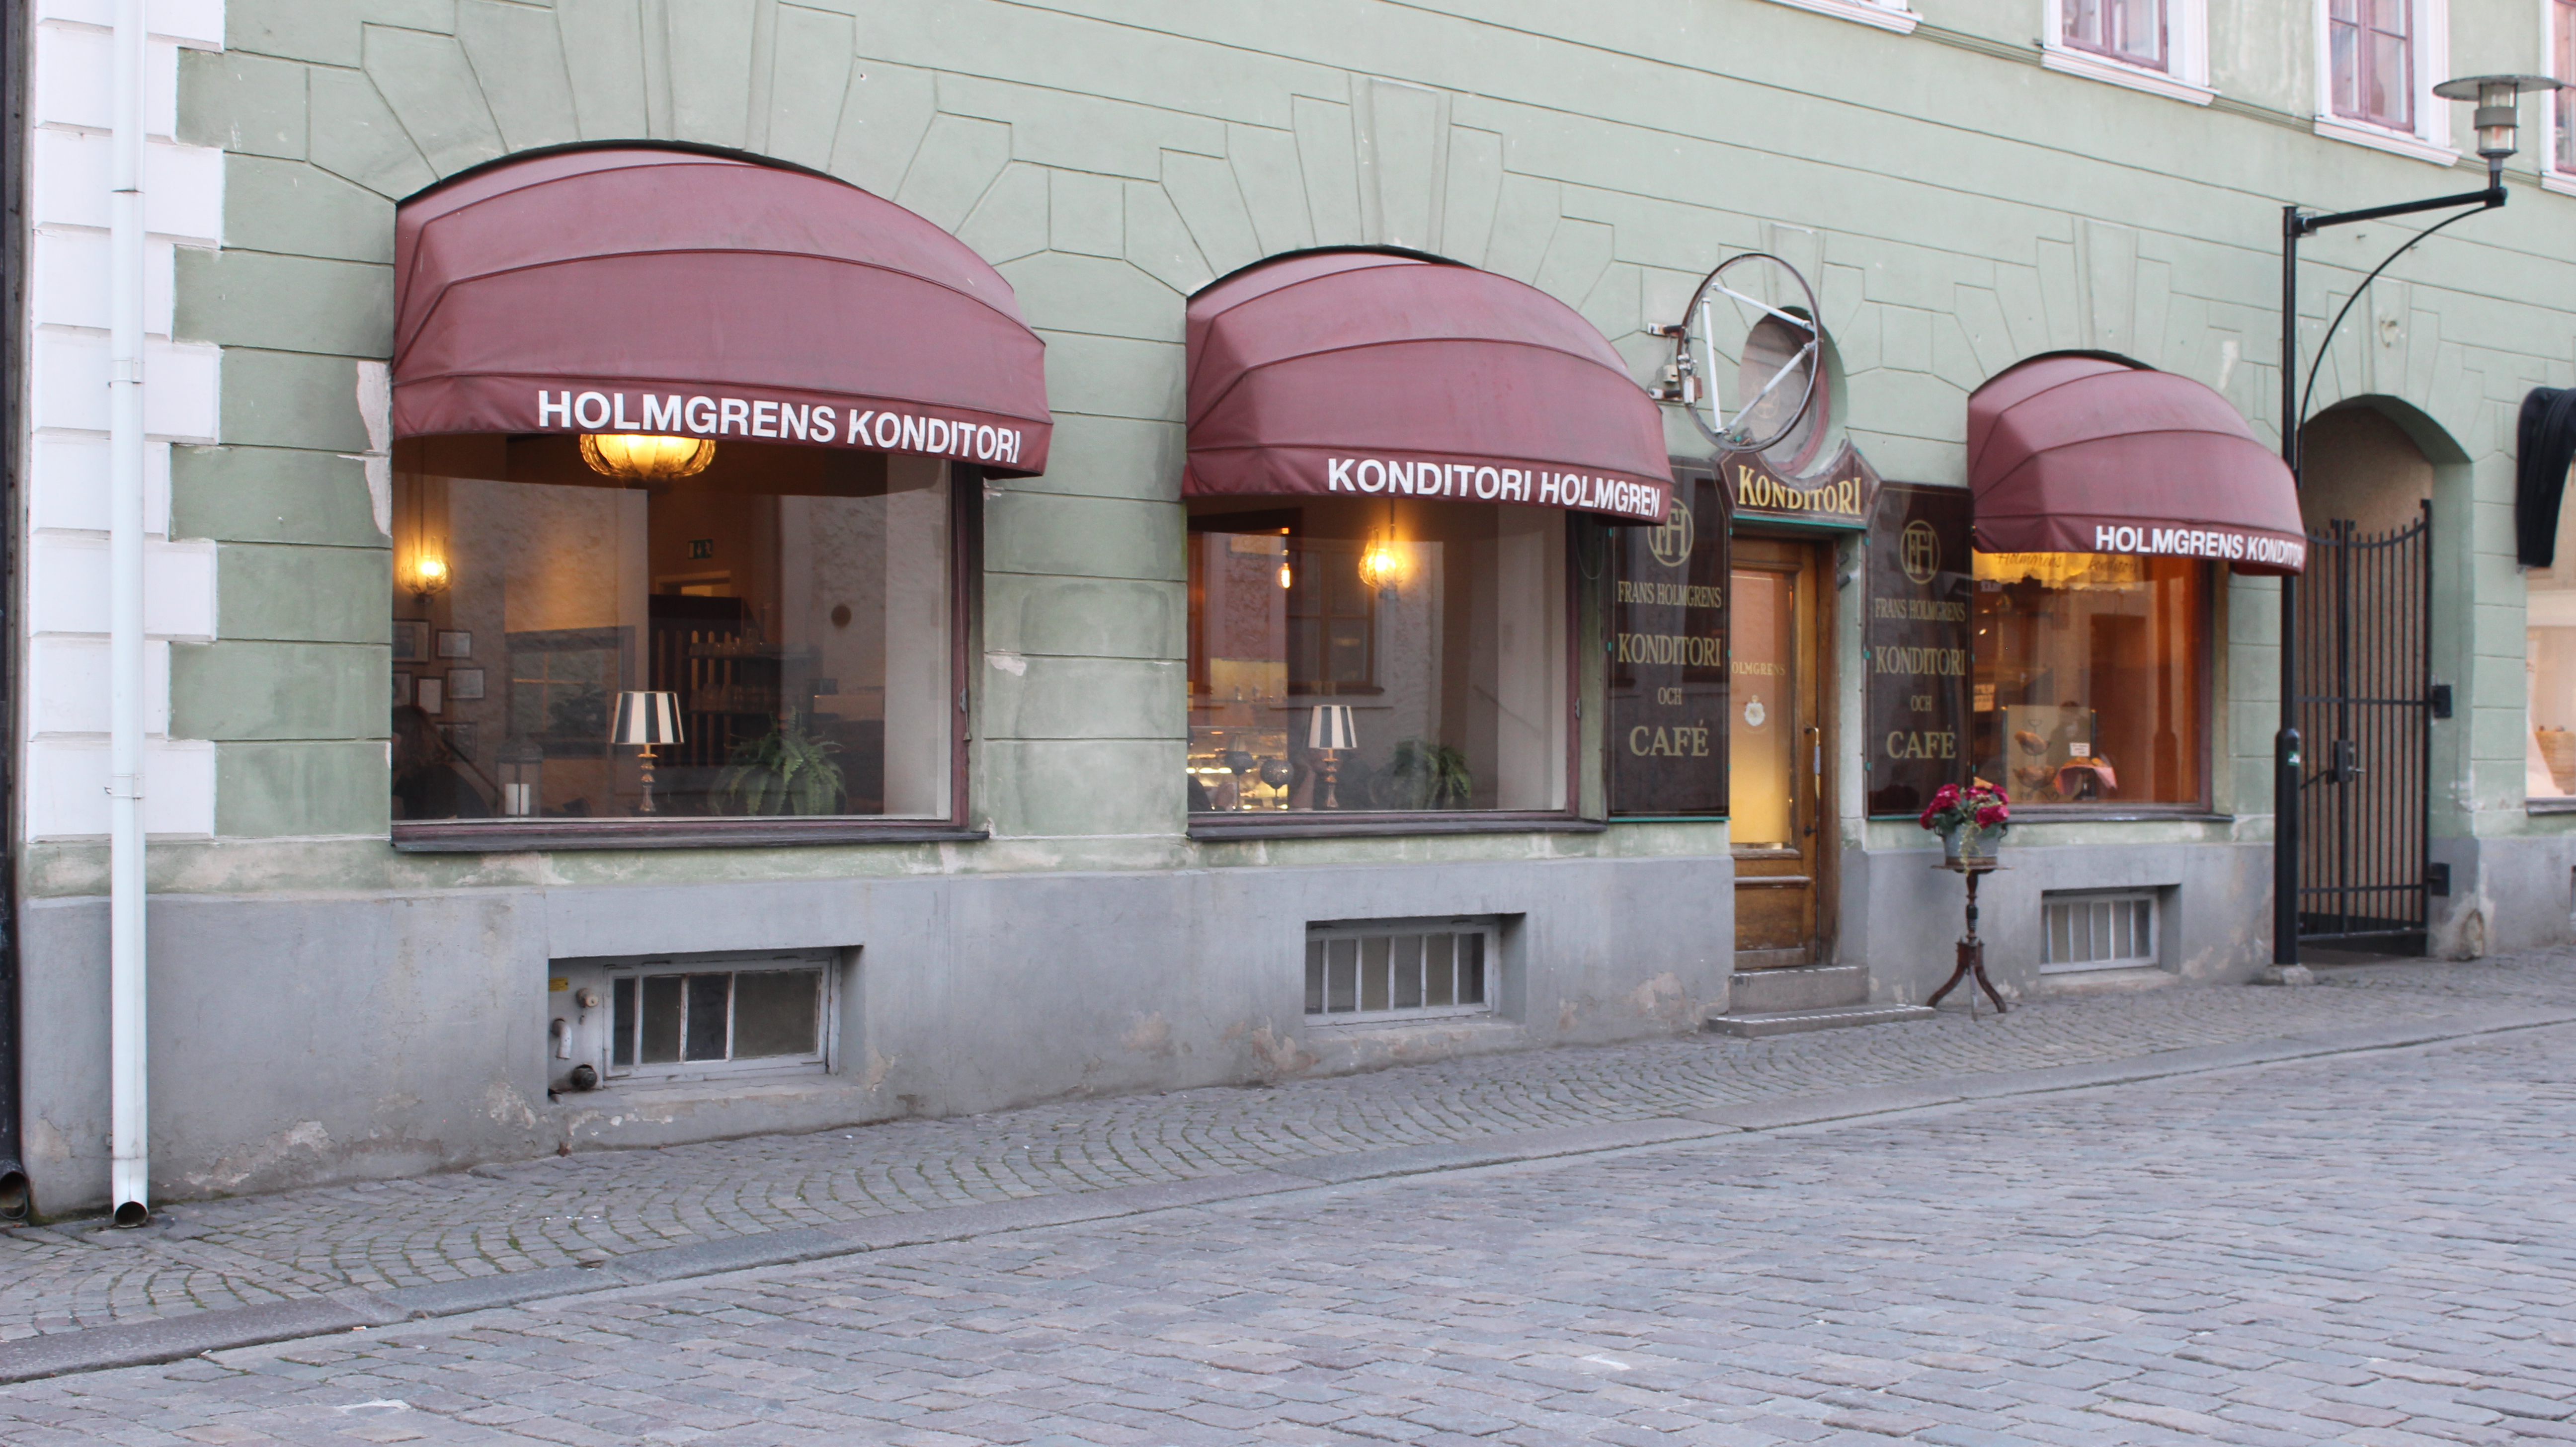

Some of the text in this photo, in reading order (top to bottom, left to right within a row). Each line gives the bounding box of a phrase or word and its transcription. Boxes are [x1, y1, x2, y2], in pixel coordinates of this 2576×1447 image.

[538, 390, 1021, 464] HOLMGRENS KONDITORI
[1328, 458, 1661, 518] KONDITORI HOLMGREN
[1737, 464, 1861, 515] KONDITORI
[2095, 525, 2244, 560] HOLMGRENS
[1617, 580, 1721, 608] FRANS HOLMGRENS
[1874, 597, 1965, 622] FRANS HOLMGRENS
[1617, 633, 1721, 666] KONDITORI
[1875, 645, 1965, 676] KONDITORI
[1657, 687, 1683, 706] OCH
[1910, 695, 1932, 712] OCH
[1629, 720, 1709, 757] CAFÉ
[1886, 725, 1956, 759] CAFÉ
